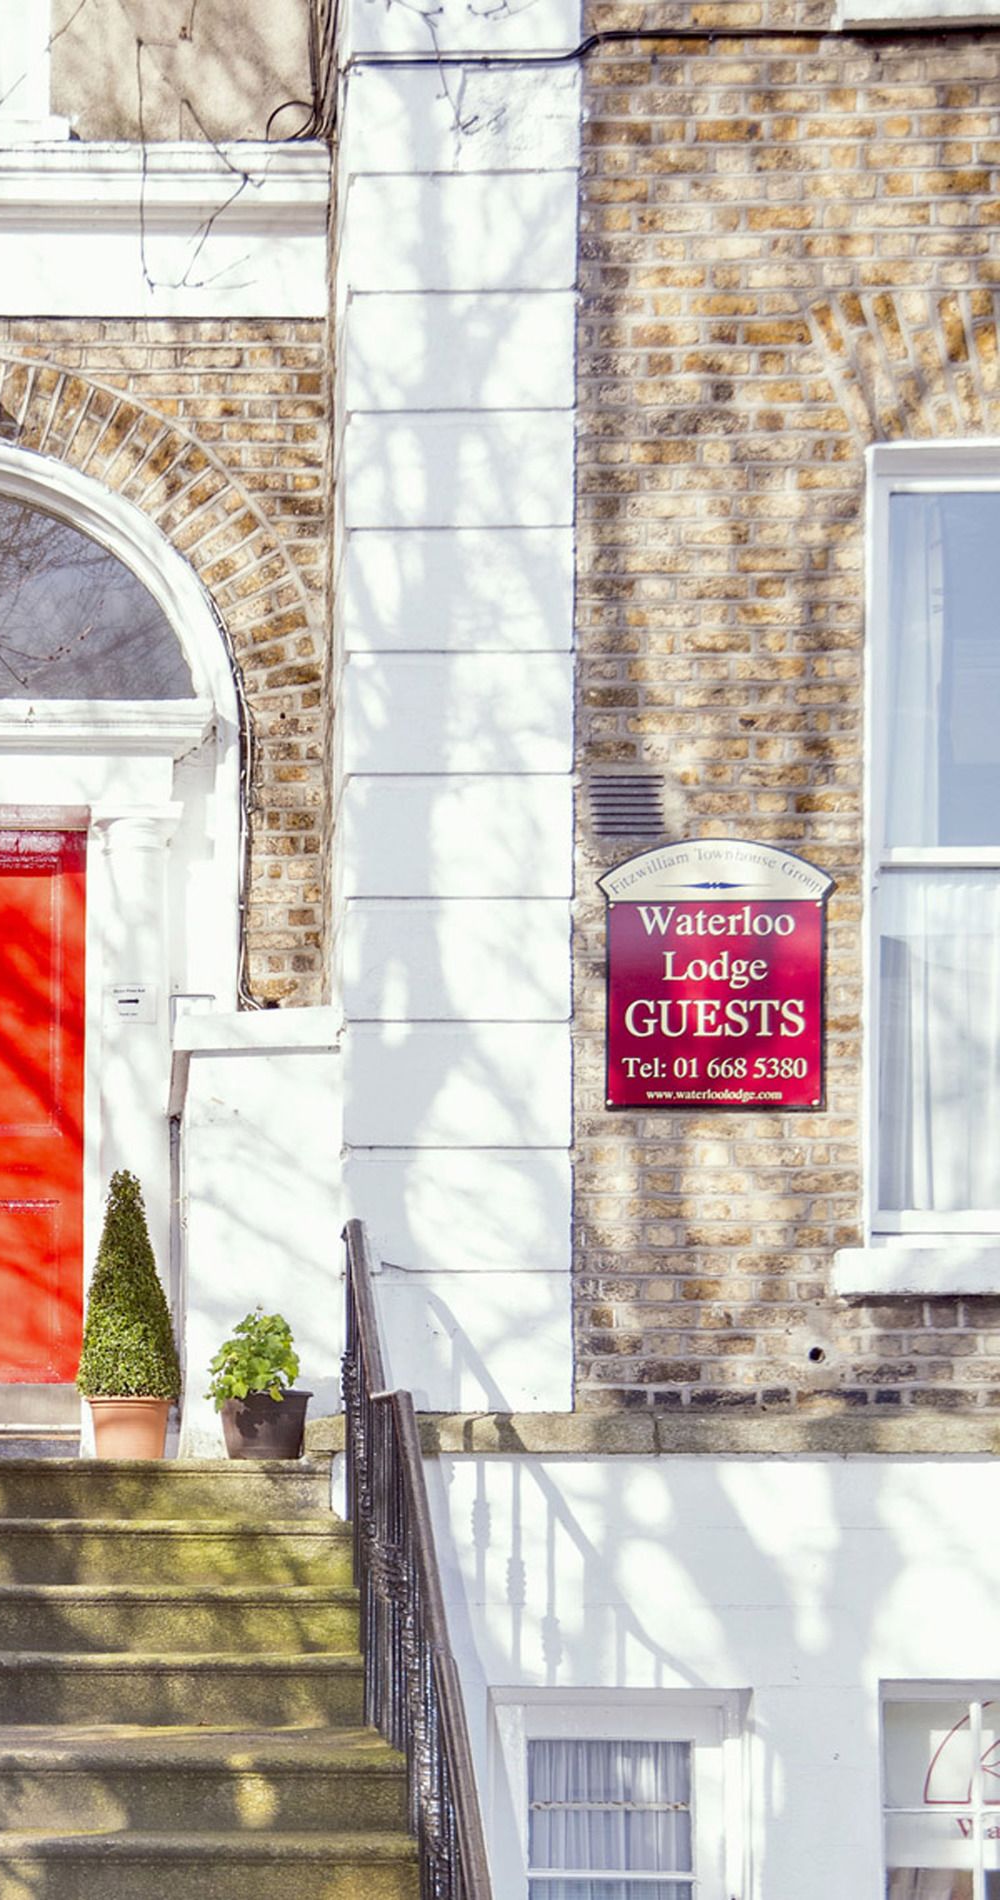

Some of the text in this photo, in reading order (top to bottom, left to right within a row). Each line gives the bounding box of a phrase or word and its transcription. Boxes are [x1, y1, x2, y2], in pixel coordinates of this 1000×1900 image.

[609, 847, 824, 895] Fitzwilliam Townhouse Group
[637, 906, 796, 936] Waterloo
[662, 951, 768, 989] Lodge
[624, 999, 806, 1038] GUESTS
[621, 1057, 808, 1079] Tel: 01 668 5380
[646, 1088, 783, 1103] www.waterloolodge.com
